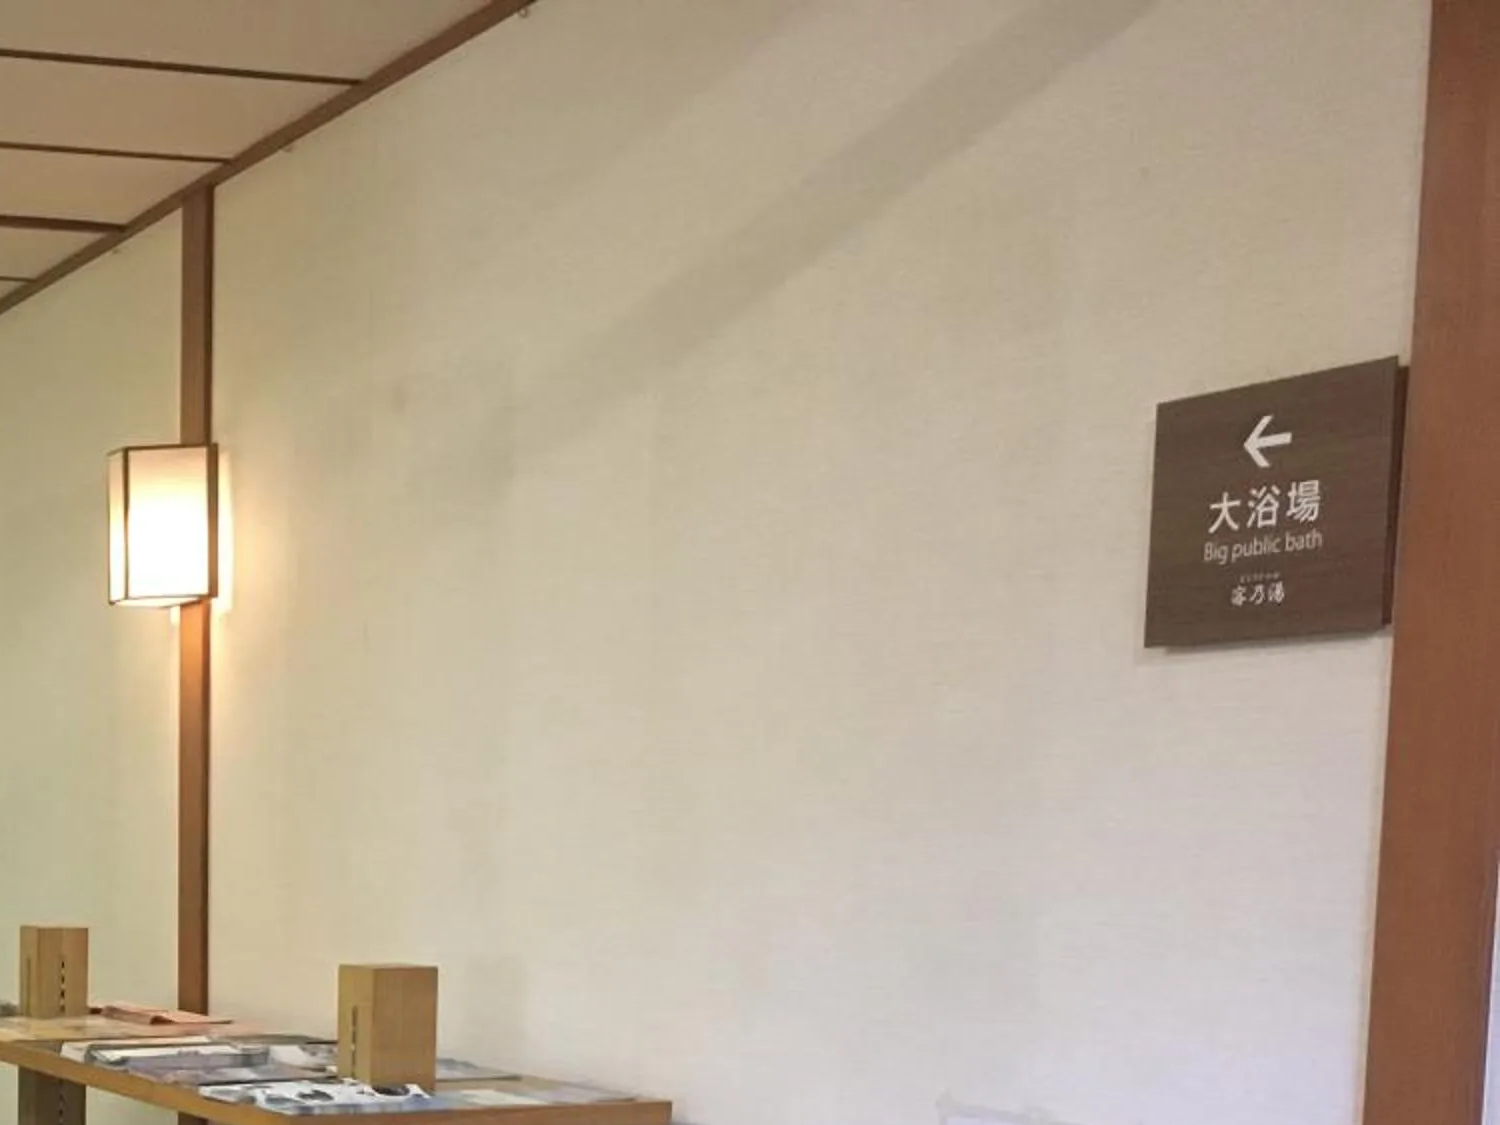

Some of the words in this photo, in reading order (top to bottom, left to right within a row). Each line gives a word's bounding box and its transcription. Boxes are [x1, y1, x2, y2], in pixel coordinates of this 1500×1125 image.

[1208, 479, 1321, 533] 大浴場
[1203, 541, 1229, 565] Big
[1231, 534, 1282, 562] public
[1284, 528, 1323, 552] bath
